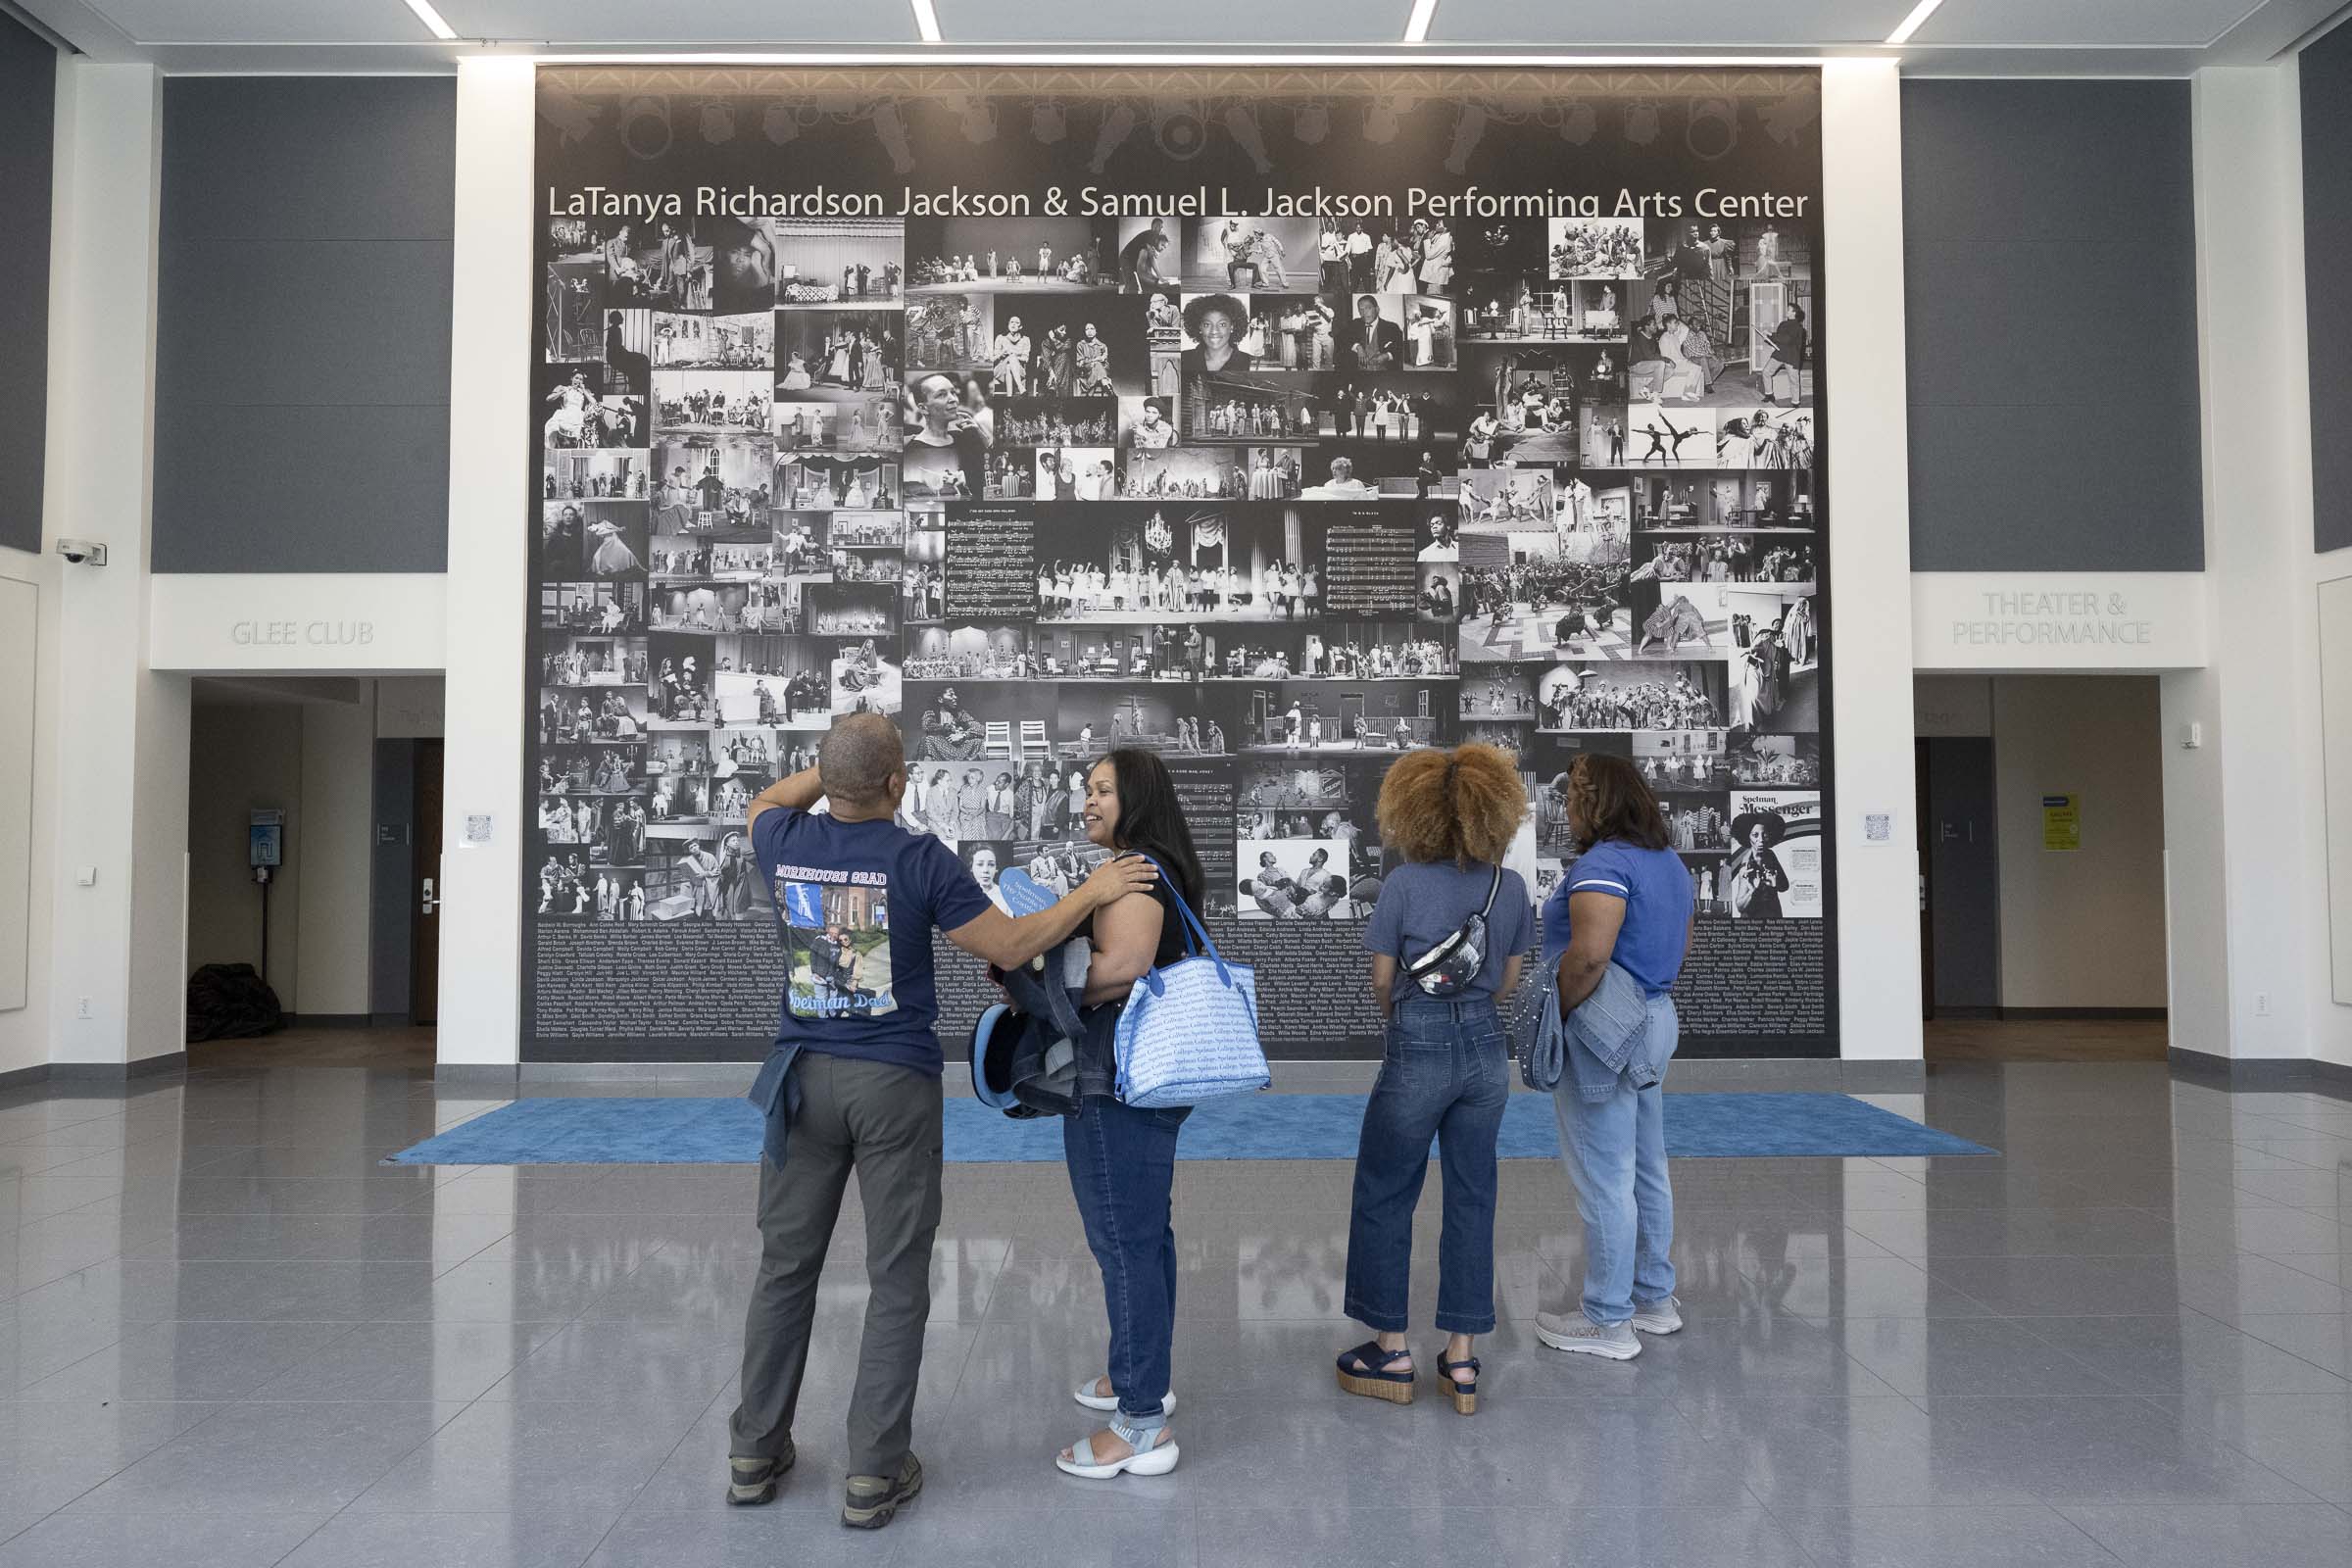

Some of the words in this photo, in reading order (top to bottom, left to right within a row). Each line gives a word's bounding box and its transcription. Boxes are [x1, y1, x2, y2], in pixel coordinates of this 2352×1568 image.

[548, 186, 682, 223] LaTanya
[696, 185, 884, 217] Richardson
[896, 185, 1031, 218] Jackson
[1043, 186, 1068, 217] &
[1081, 185, 1207, 217] Samuel
[1220, 186, 1248, 217] L.
[1259, 185, 1394, 218] Jackson
[1407, 185, 1599, 224] Performing
[1614, 186, 1682, 218] Arts
[1694, 187, 1808, 219] Center
[1982, 592, 2100, 615] THEATER
[2107, 592, 2127, 615] &
[232, 620, 297, 645] GLEE
[306, 620, 374, 645] CLUB
[1952, 621, 2152, 645] PERFORMANCE
[1740, 804, 1812, 817] Messenger
[1742, 795, 1778, 805] Spelman
[776, 863, 849, 883] MOREHOUSE
[851, 871, 887, 886] GRAD
[853, 989, 892, 1007] Dad
